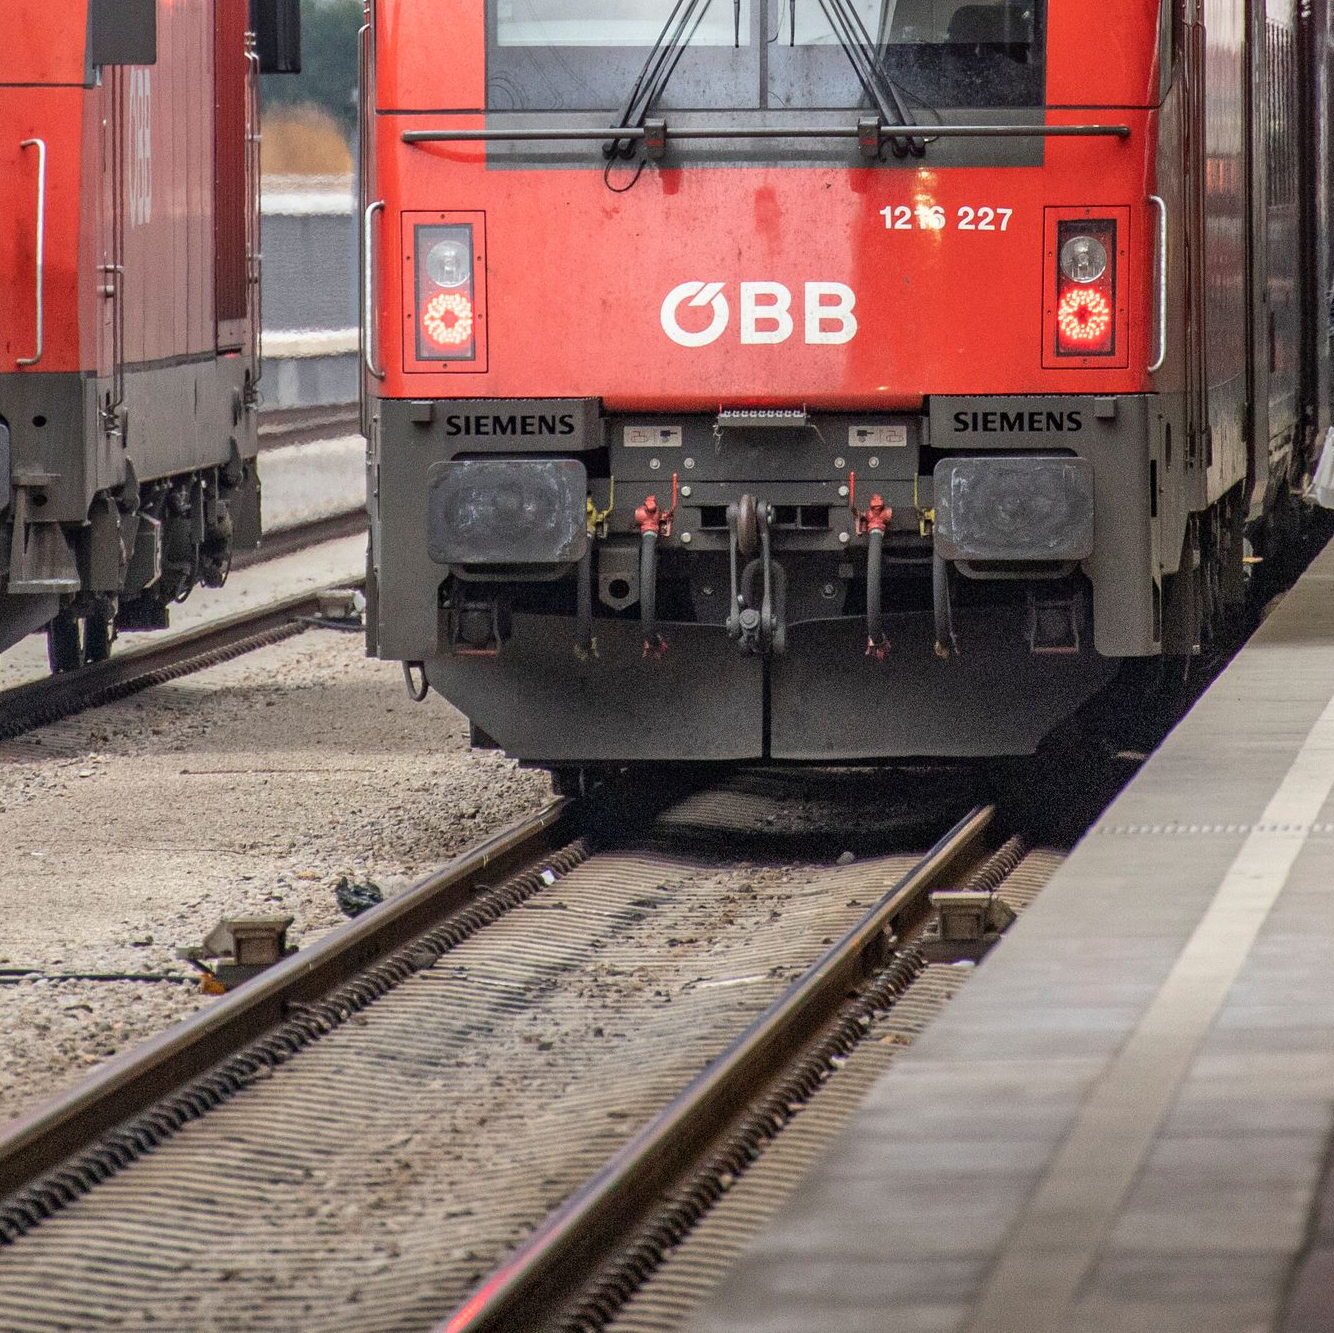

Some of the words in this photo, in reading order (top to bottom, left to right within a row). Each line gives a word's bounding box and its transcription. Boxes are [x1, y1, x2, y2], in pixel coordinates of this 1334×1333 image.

[880, 206, 947, 231] 1216
[957, 206, 1014, 232] 227
[660, 280, 859, 348] ÖBB
[445, 414, 575, 436] SIEMENS
[953, 411, 1083, 433] SIEMENS
